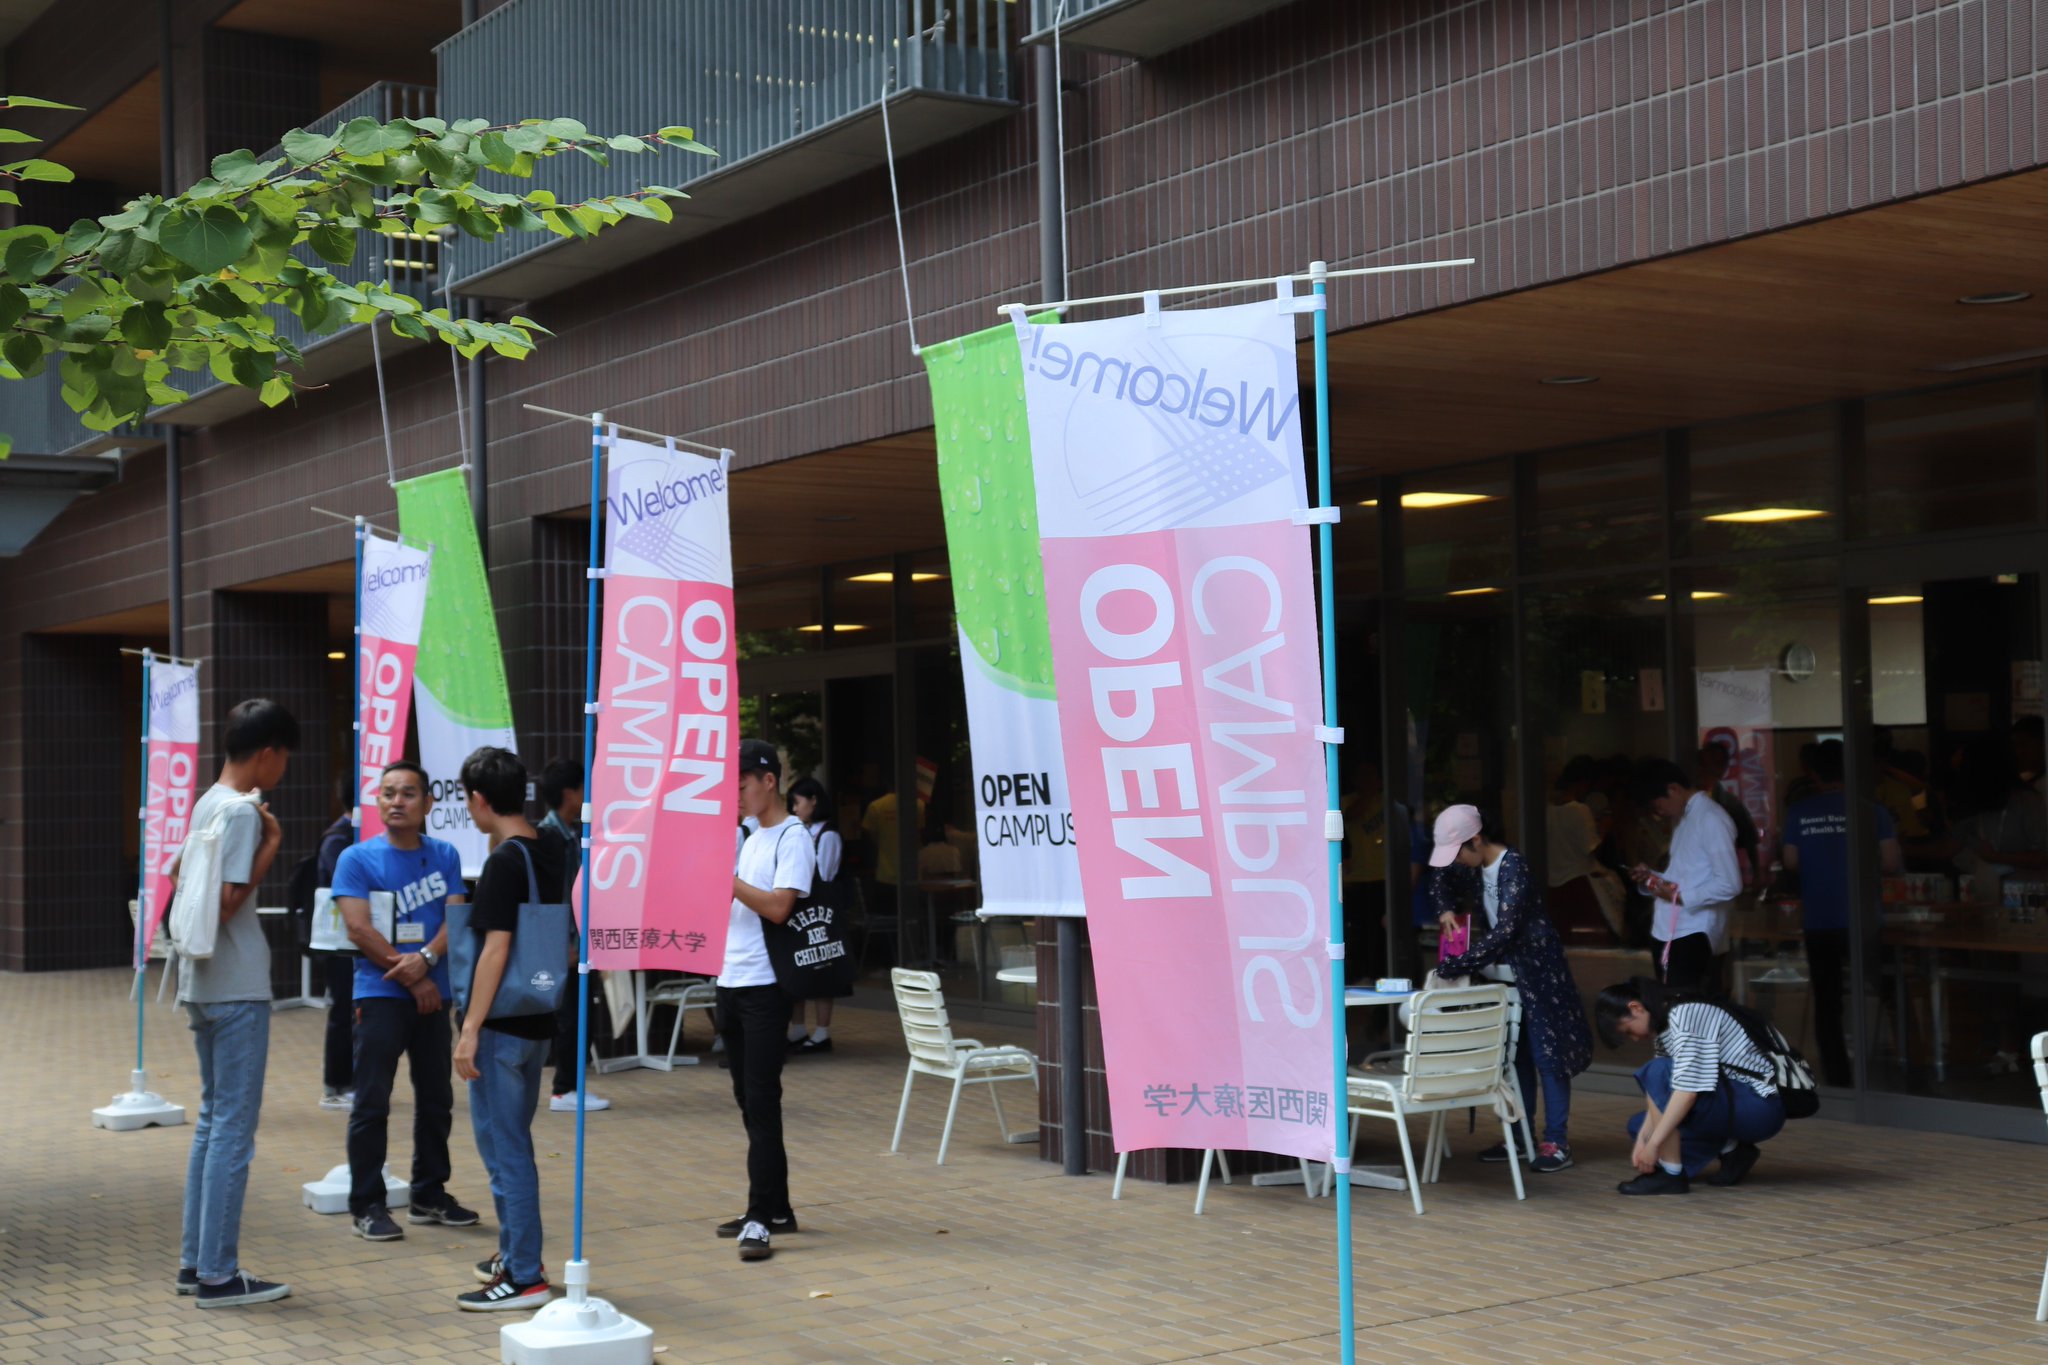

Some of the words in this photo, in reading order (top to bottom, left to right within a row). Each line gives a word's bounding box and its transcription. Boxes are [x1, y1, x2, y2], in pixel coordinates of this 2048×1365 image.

[607, 459, 726, 526] Welcome!
[362, 559, 429, 595] elcome
[662, 599, 728, 815] OPEN
[592, 595, 674, 889] CAMPUS
[430, 779, 465, 802] OPE
[981, 772, 1052, 807] OPEN
[160, 752, 193, 876] OPEN
[430, 807, 472, 830] CAMP
[787, 905, 834, 932] THERE
[589, 927, 708, 953] 関西医療大学
[806, 925, 829, 946] ARE
[793, 939, 846, 967] CHILDREN
